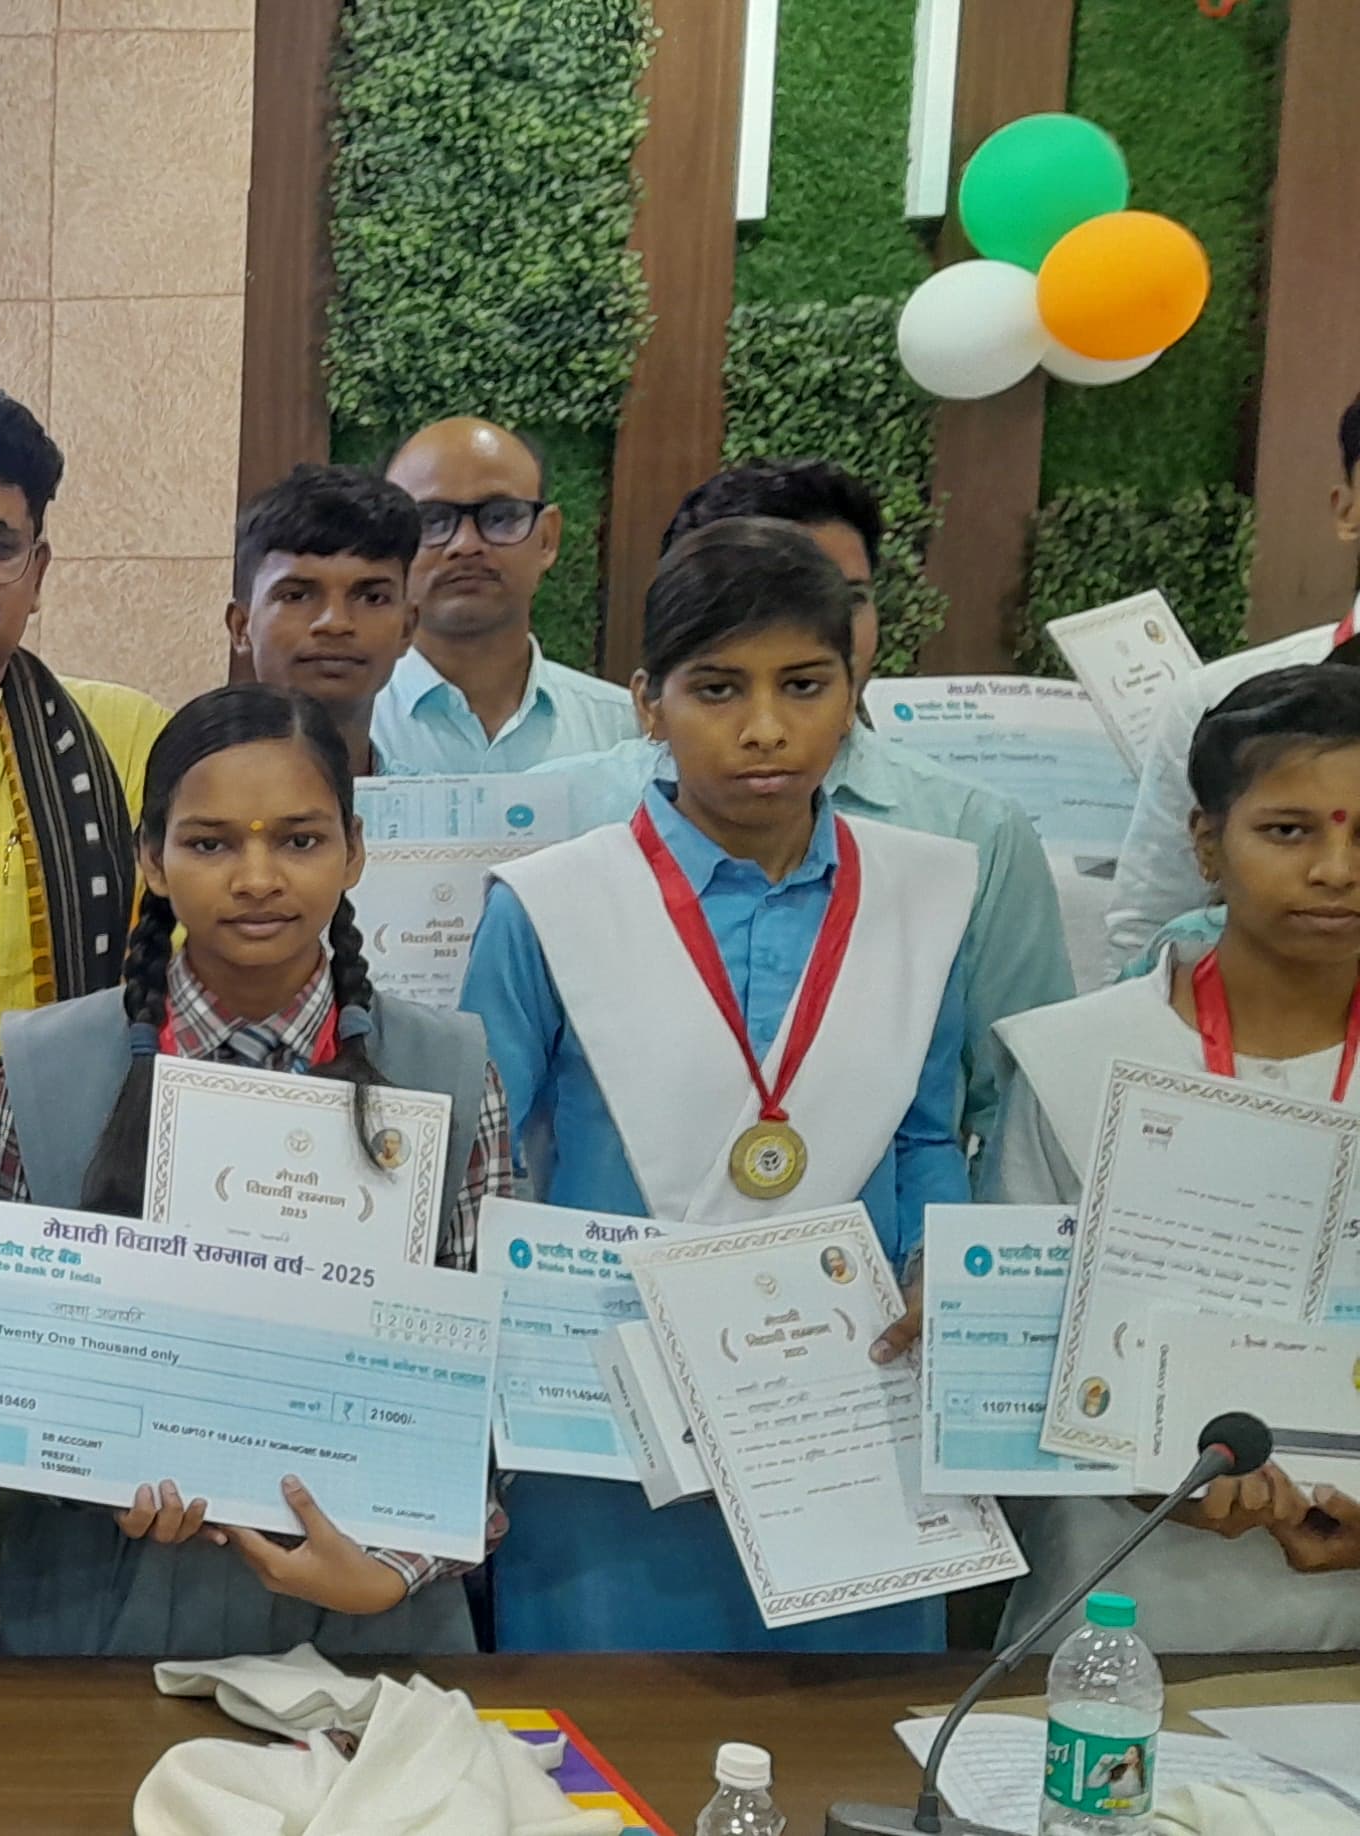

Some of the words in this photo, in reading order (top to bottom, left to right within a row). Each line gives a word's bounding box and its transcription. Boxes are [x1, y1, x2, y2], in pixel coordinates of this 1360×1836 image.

[14, 1262, 48, 1278] Bank
[69, 1271, 103, 1286] India
[192, 1241, 268, 1270] सम्मान
[321, 1262, 376, 1289] 2025
[48, 1330, 77, 1346] One
[80, 1335, 148, 1358] Thousand
[150, 1345, 181, 1366] only
